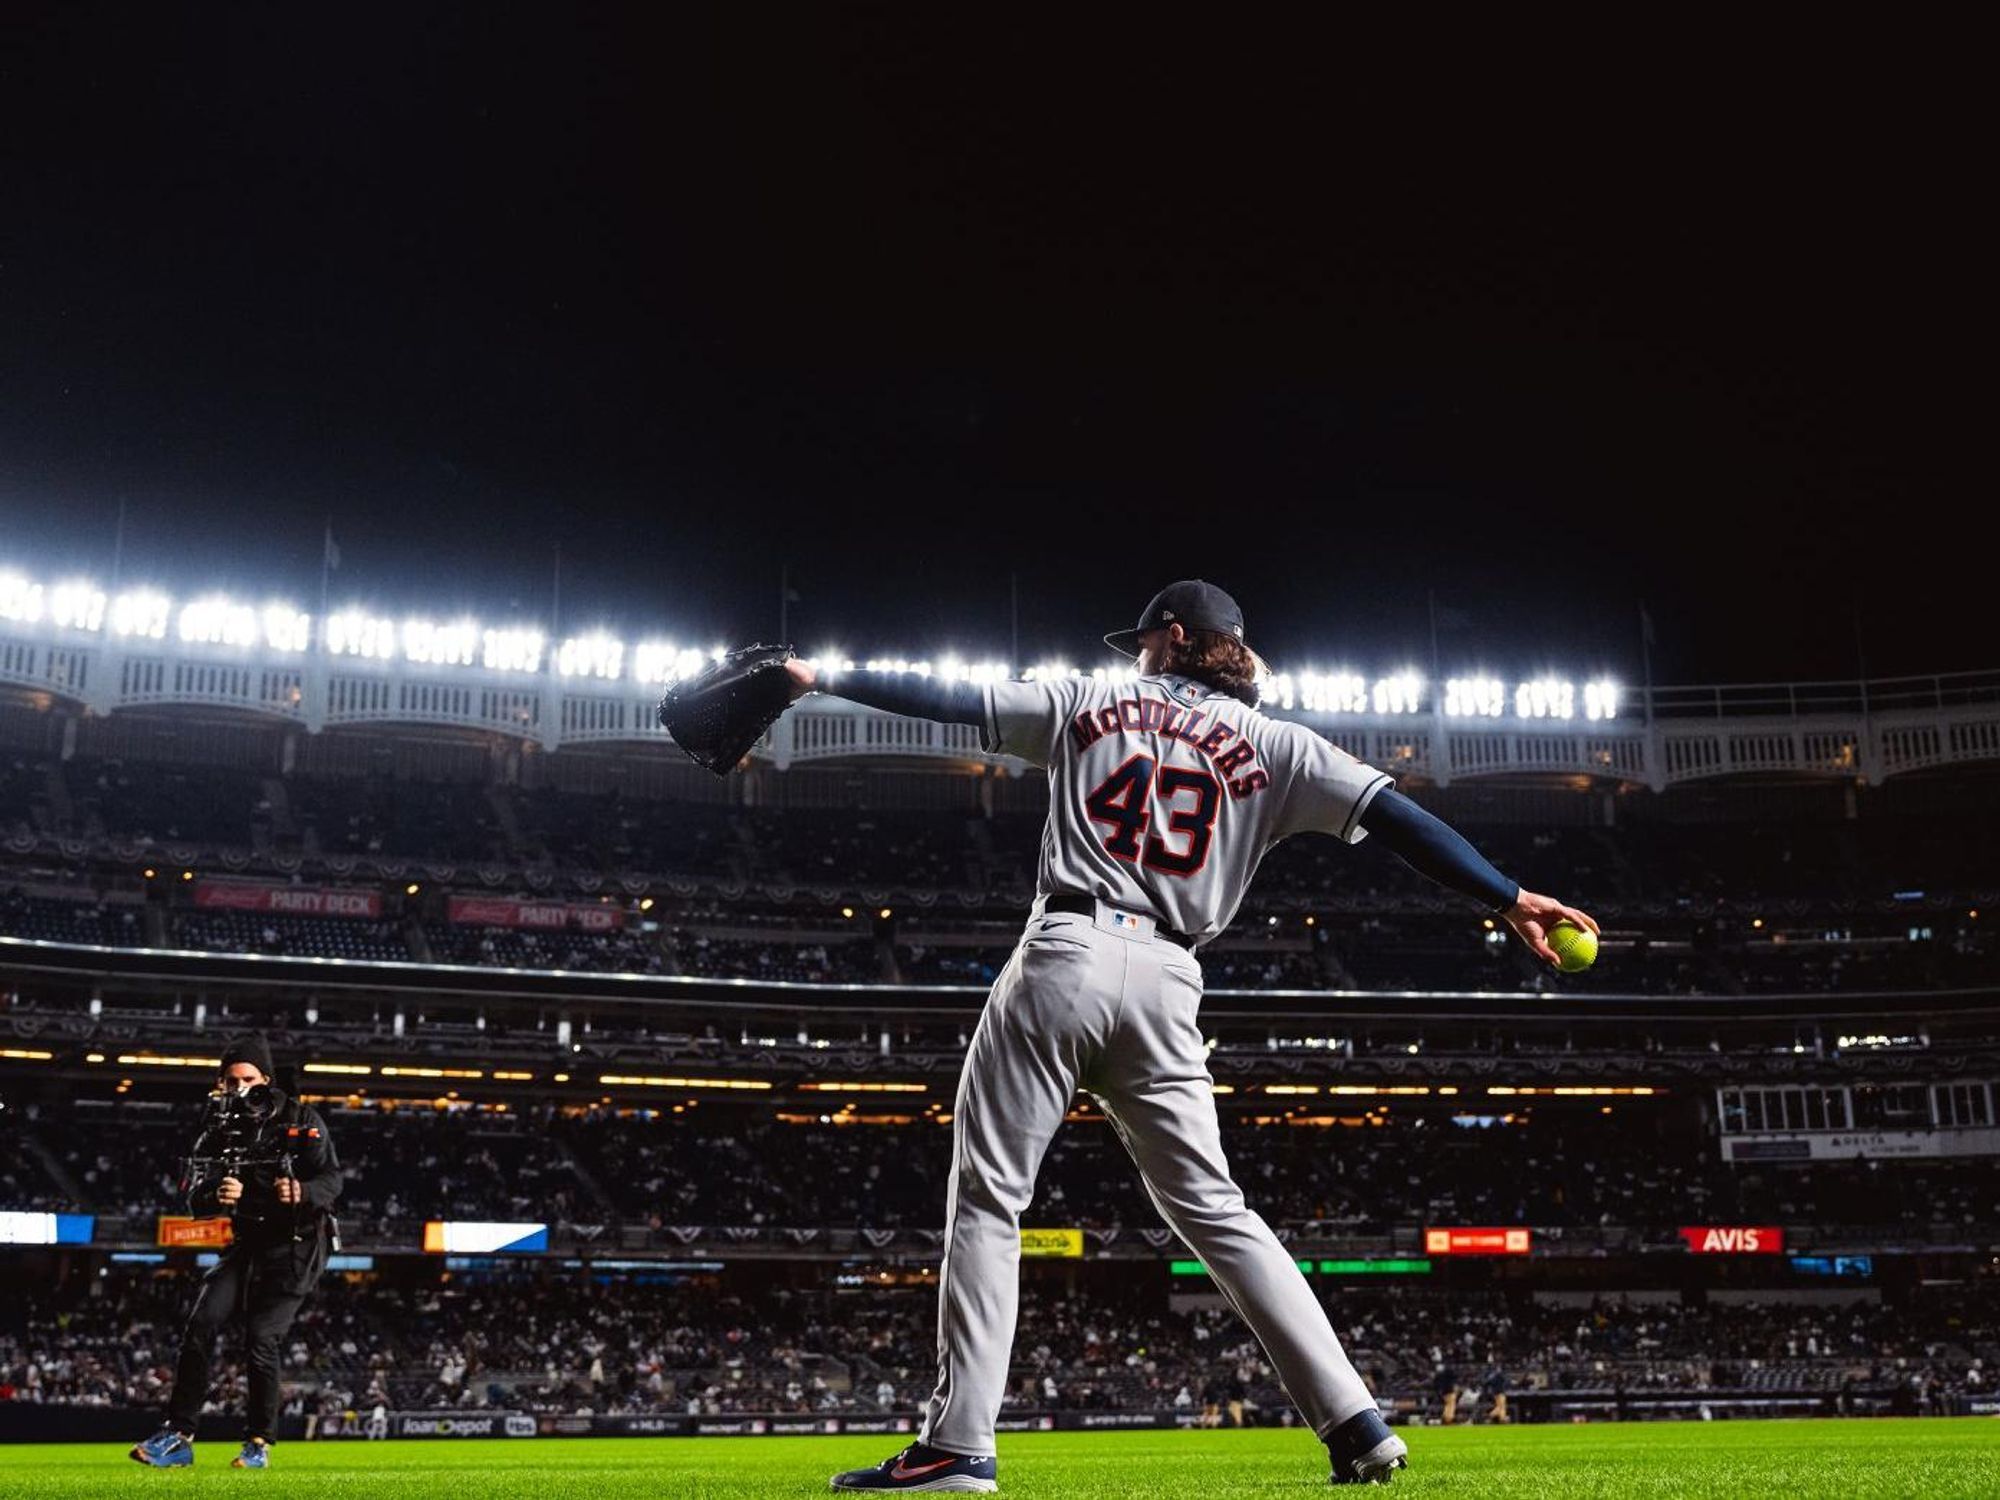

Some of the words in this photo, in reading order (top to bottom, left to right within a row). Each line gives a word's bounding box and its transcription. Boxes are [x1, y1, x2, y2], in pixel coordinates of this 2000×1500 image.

[1085, 752, 1223, 879] 43
[271, 891, 323, 911] PARTY
[325, 894, 370, 914] DECK
[519, 905, 568, 927] PARTY
[573, 908, 614, 930] ECK
[1702, 1228, 1760, 1252] AVIS
[402, 1417, 493, 1436] loanDepot
